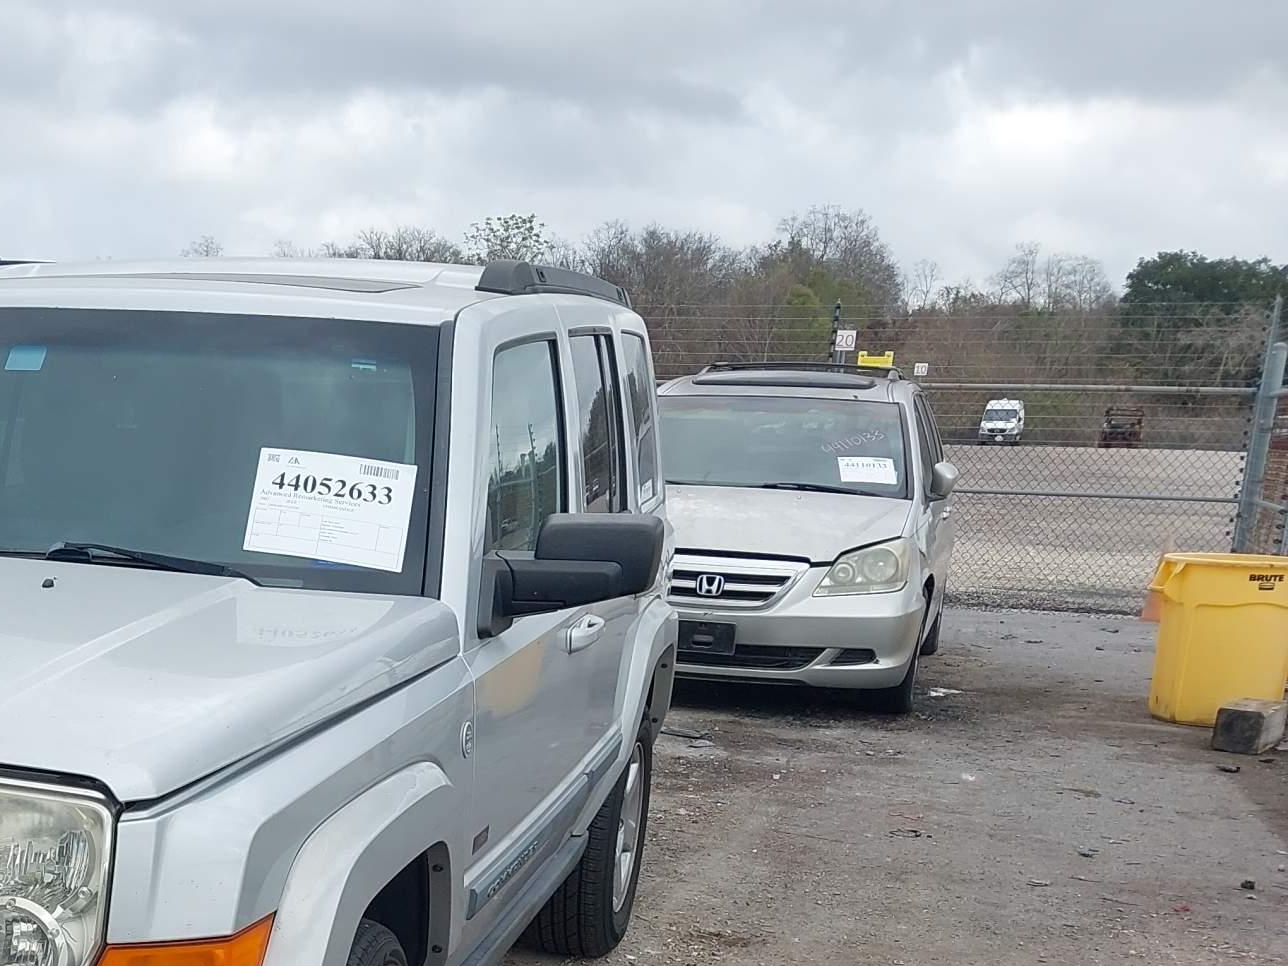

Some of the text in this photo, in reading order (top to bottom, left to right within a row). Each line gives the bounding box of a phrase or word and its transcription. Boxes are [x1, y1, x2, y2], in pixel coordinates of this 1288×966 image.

[836, 334, 854, 347] 20
[915, 364, 927, 375] 10
[271, 471, 393, 505] 44052633
[1248, 574, 1285, 582] BRUTE
